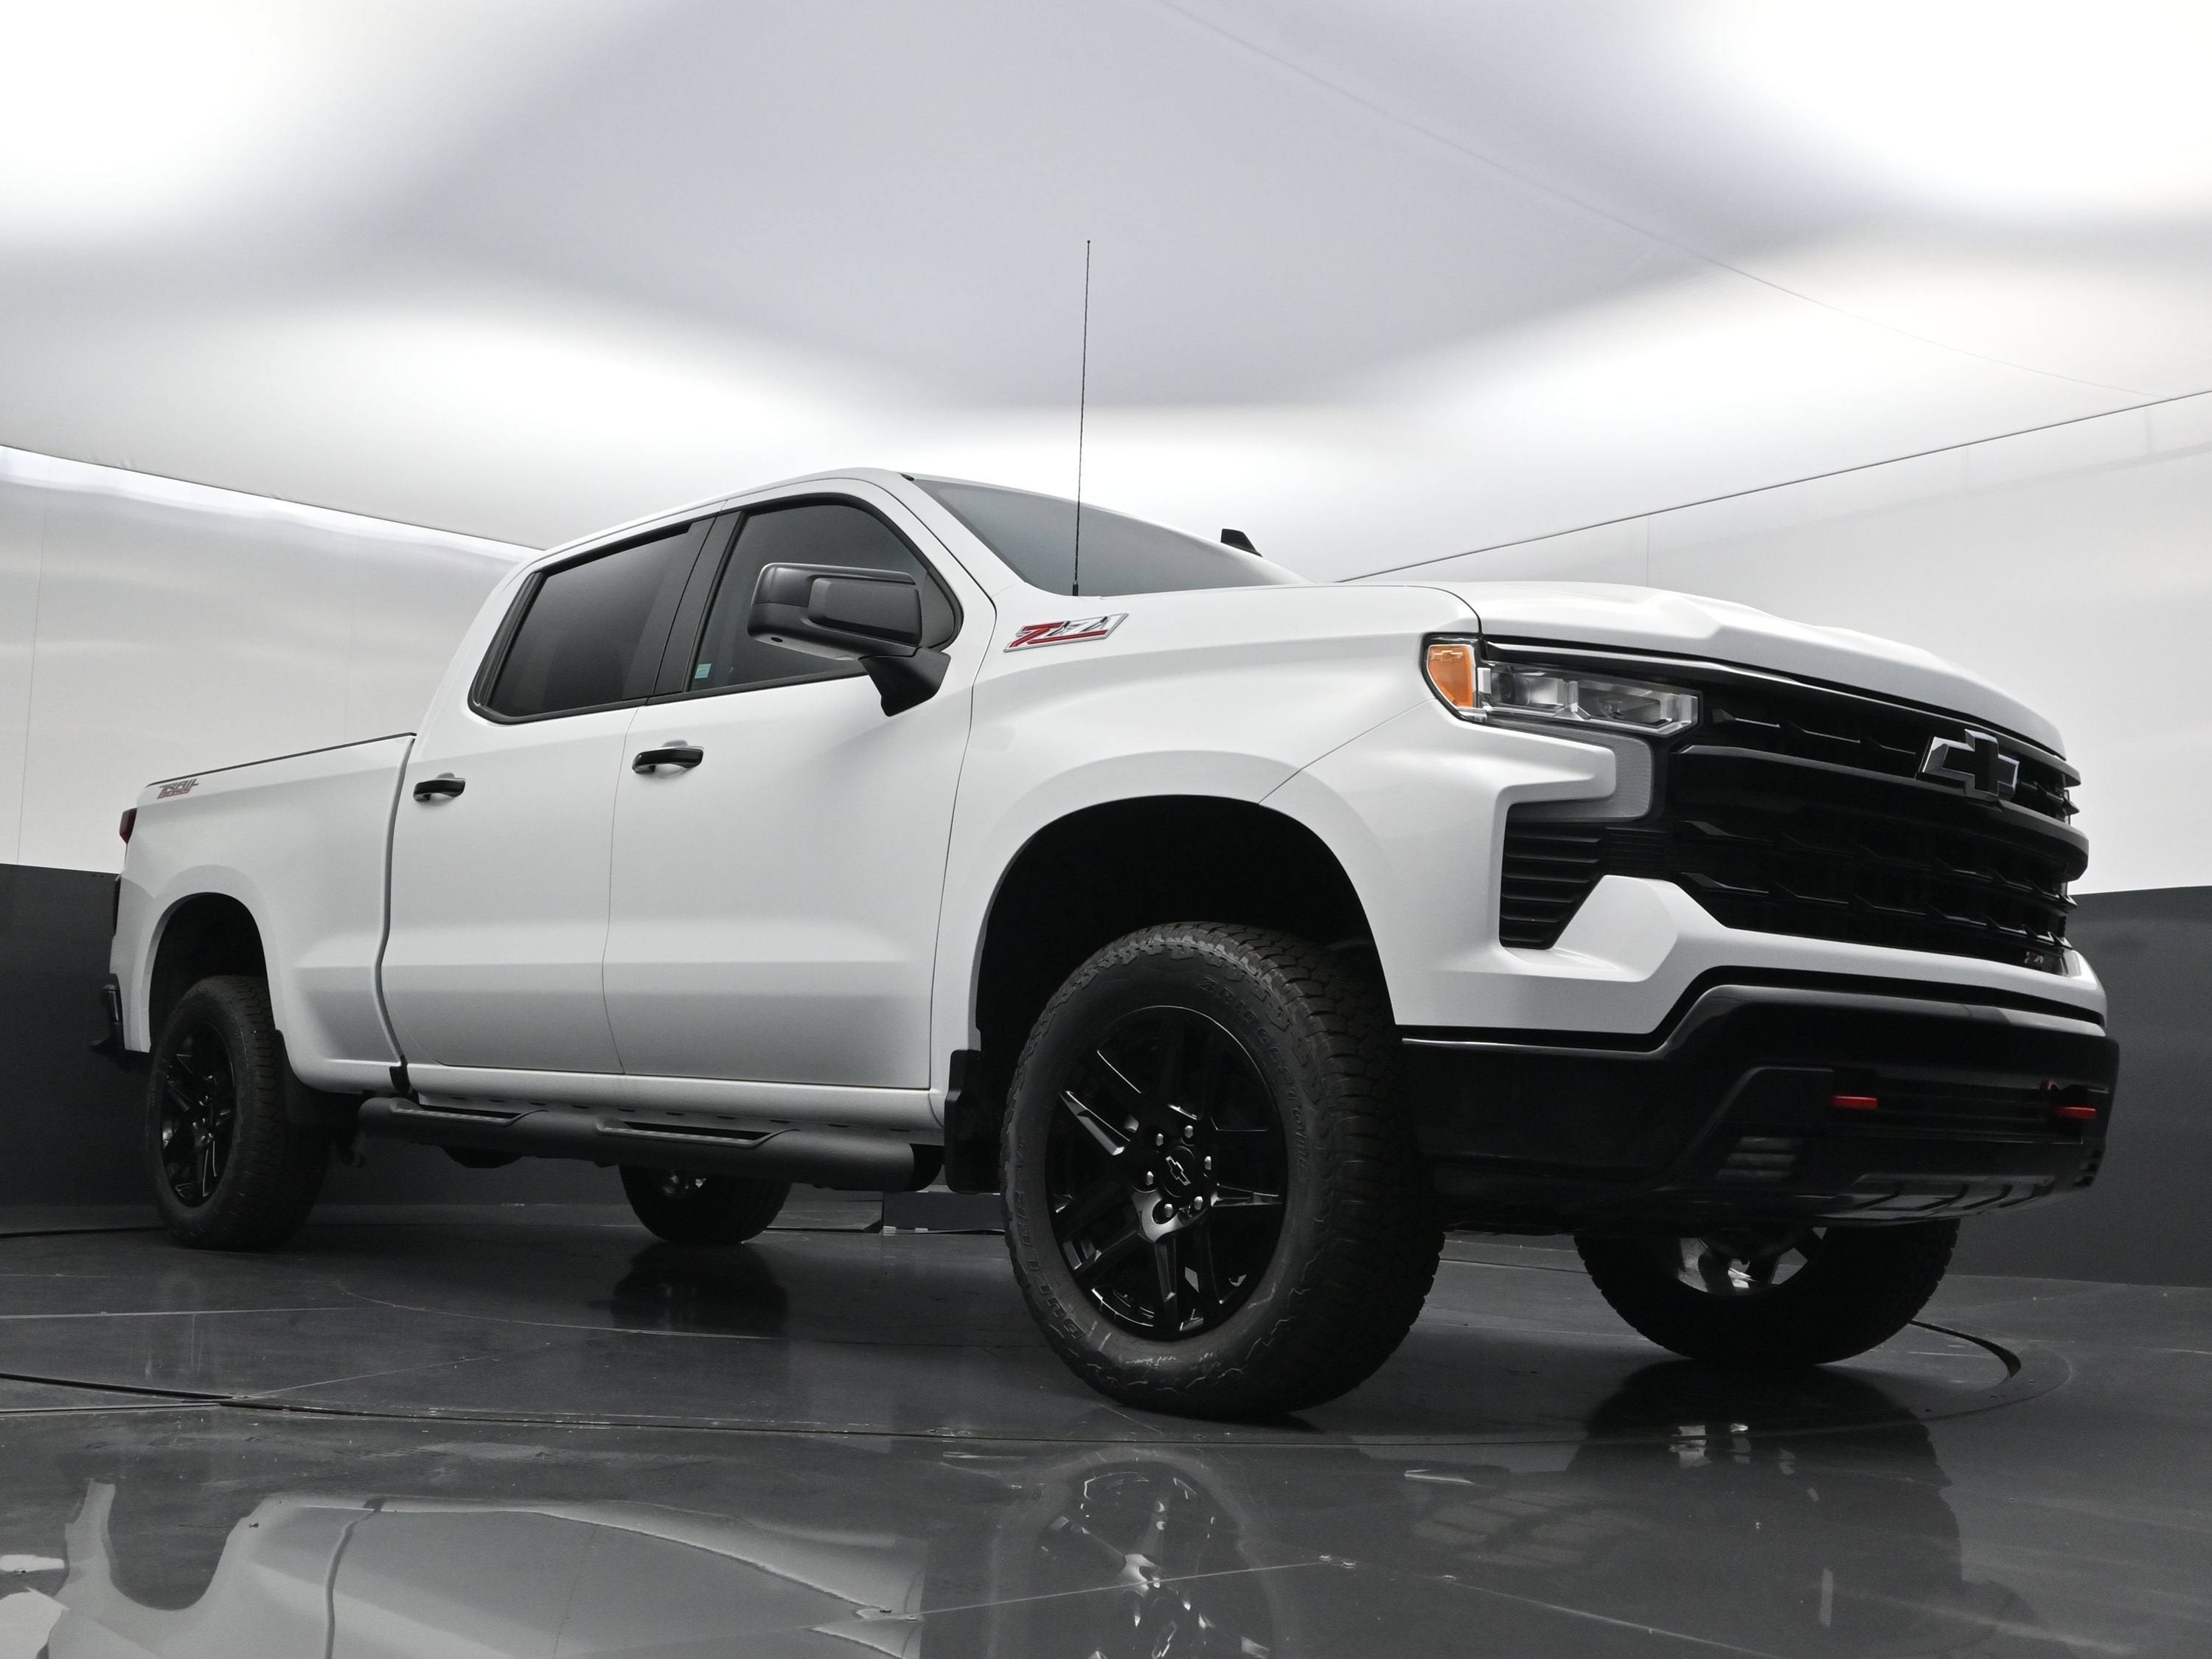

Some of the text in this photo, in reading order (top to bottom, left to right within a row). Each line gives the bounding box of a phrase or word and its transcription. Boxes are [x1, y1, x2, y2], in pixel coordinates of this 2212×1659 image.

[1003, 613, 1129, 653] Z71
[159, 778, 200, 792] TRAIL
[156, 787, 190, 799] BOSS
